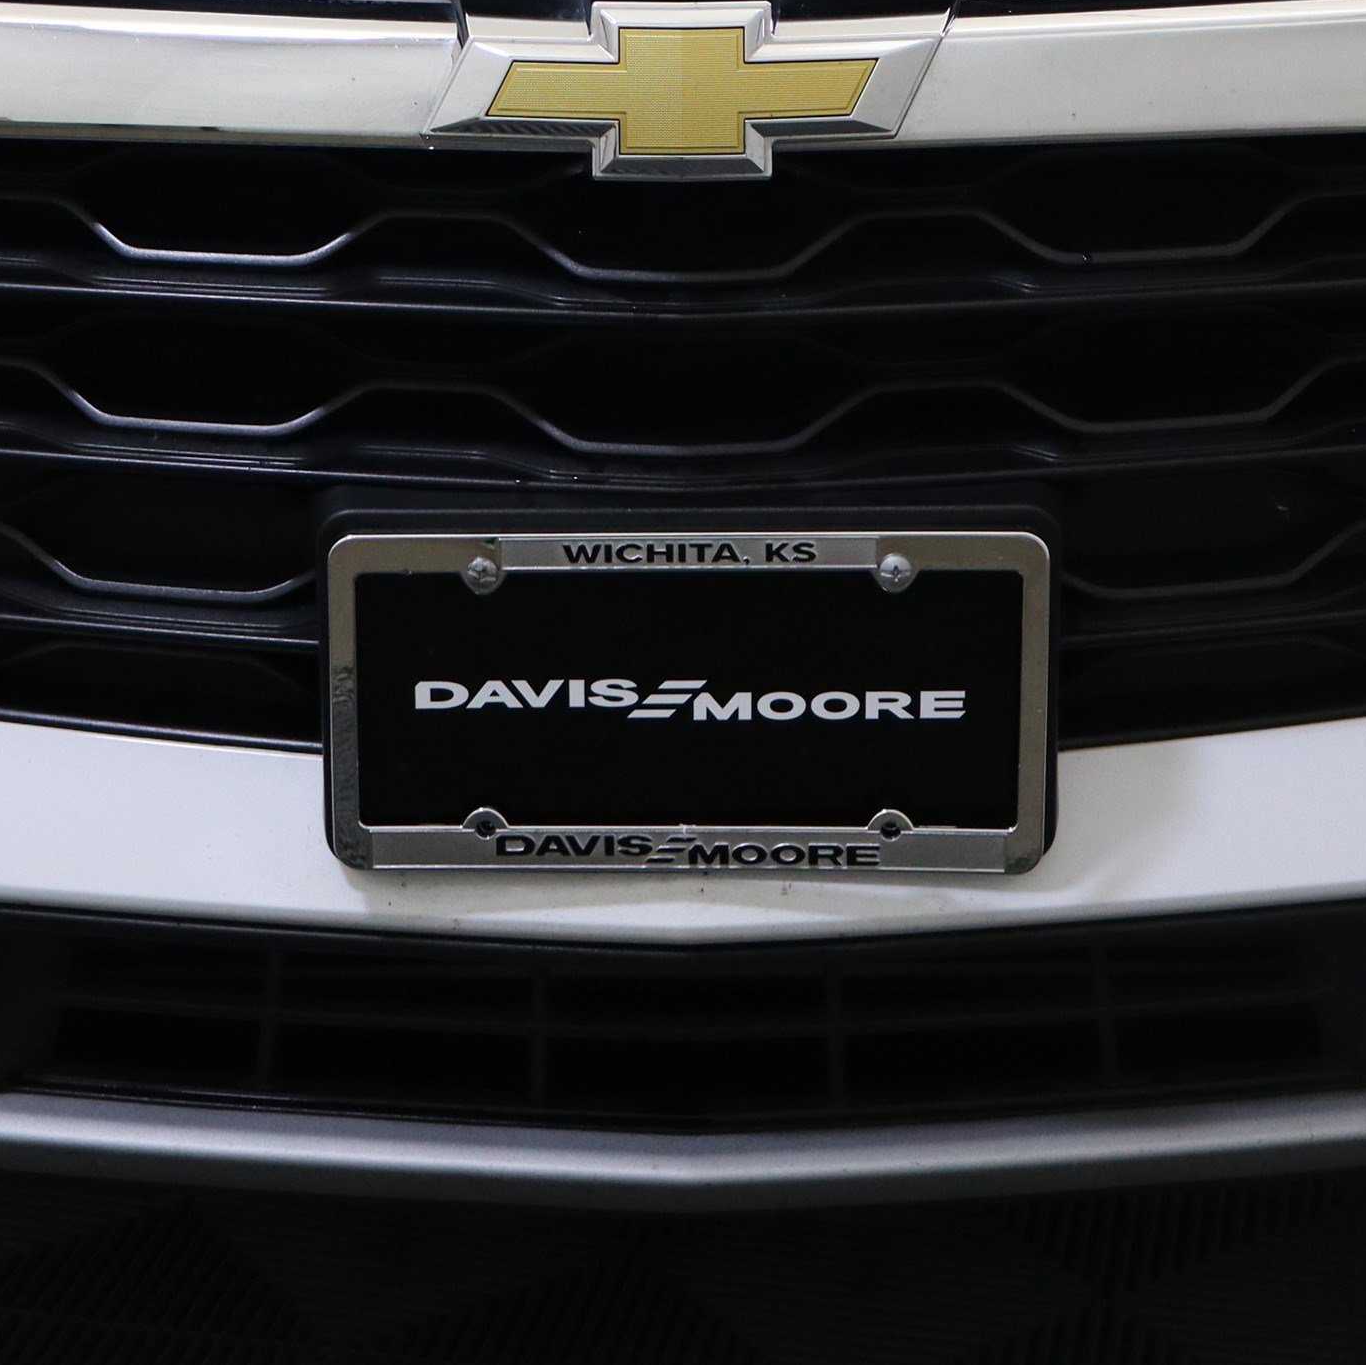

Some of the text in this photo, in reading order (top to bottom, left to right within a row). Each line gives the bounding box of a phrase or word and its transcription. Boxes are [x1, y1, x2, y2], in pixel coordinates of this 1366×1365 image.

[562, 542, 817, 566] WICHITA, KS
[414, 679, 967, 721] DAVIS MOORE
[496, 834, 880, 866] DAVIS MOORE
